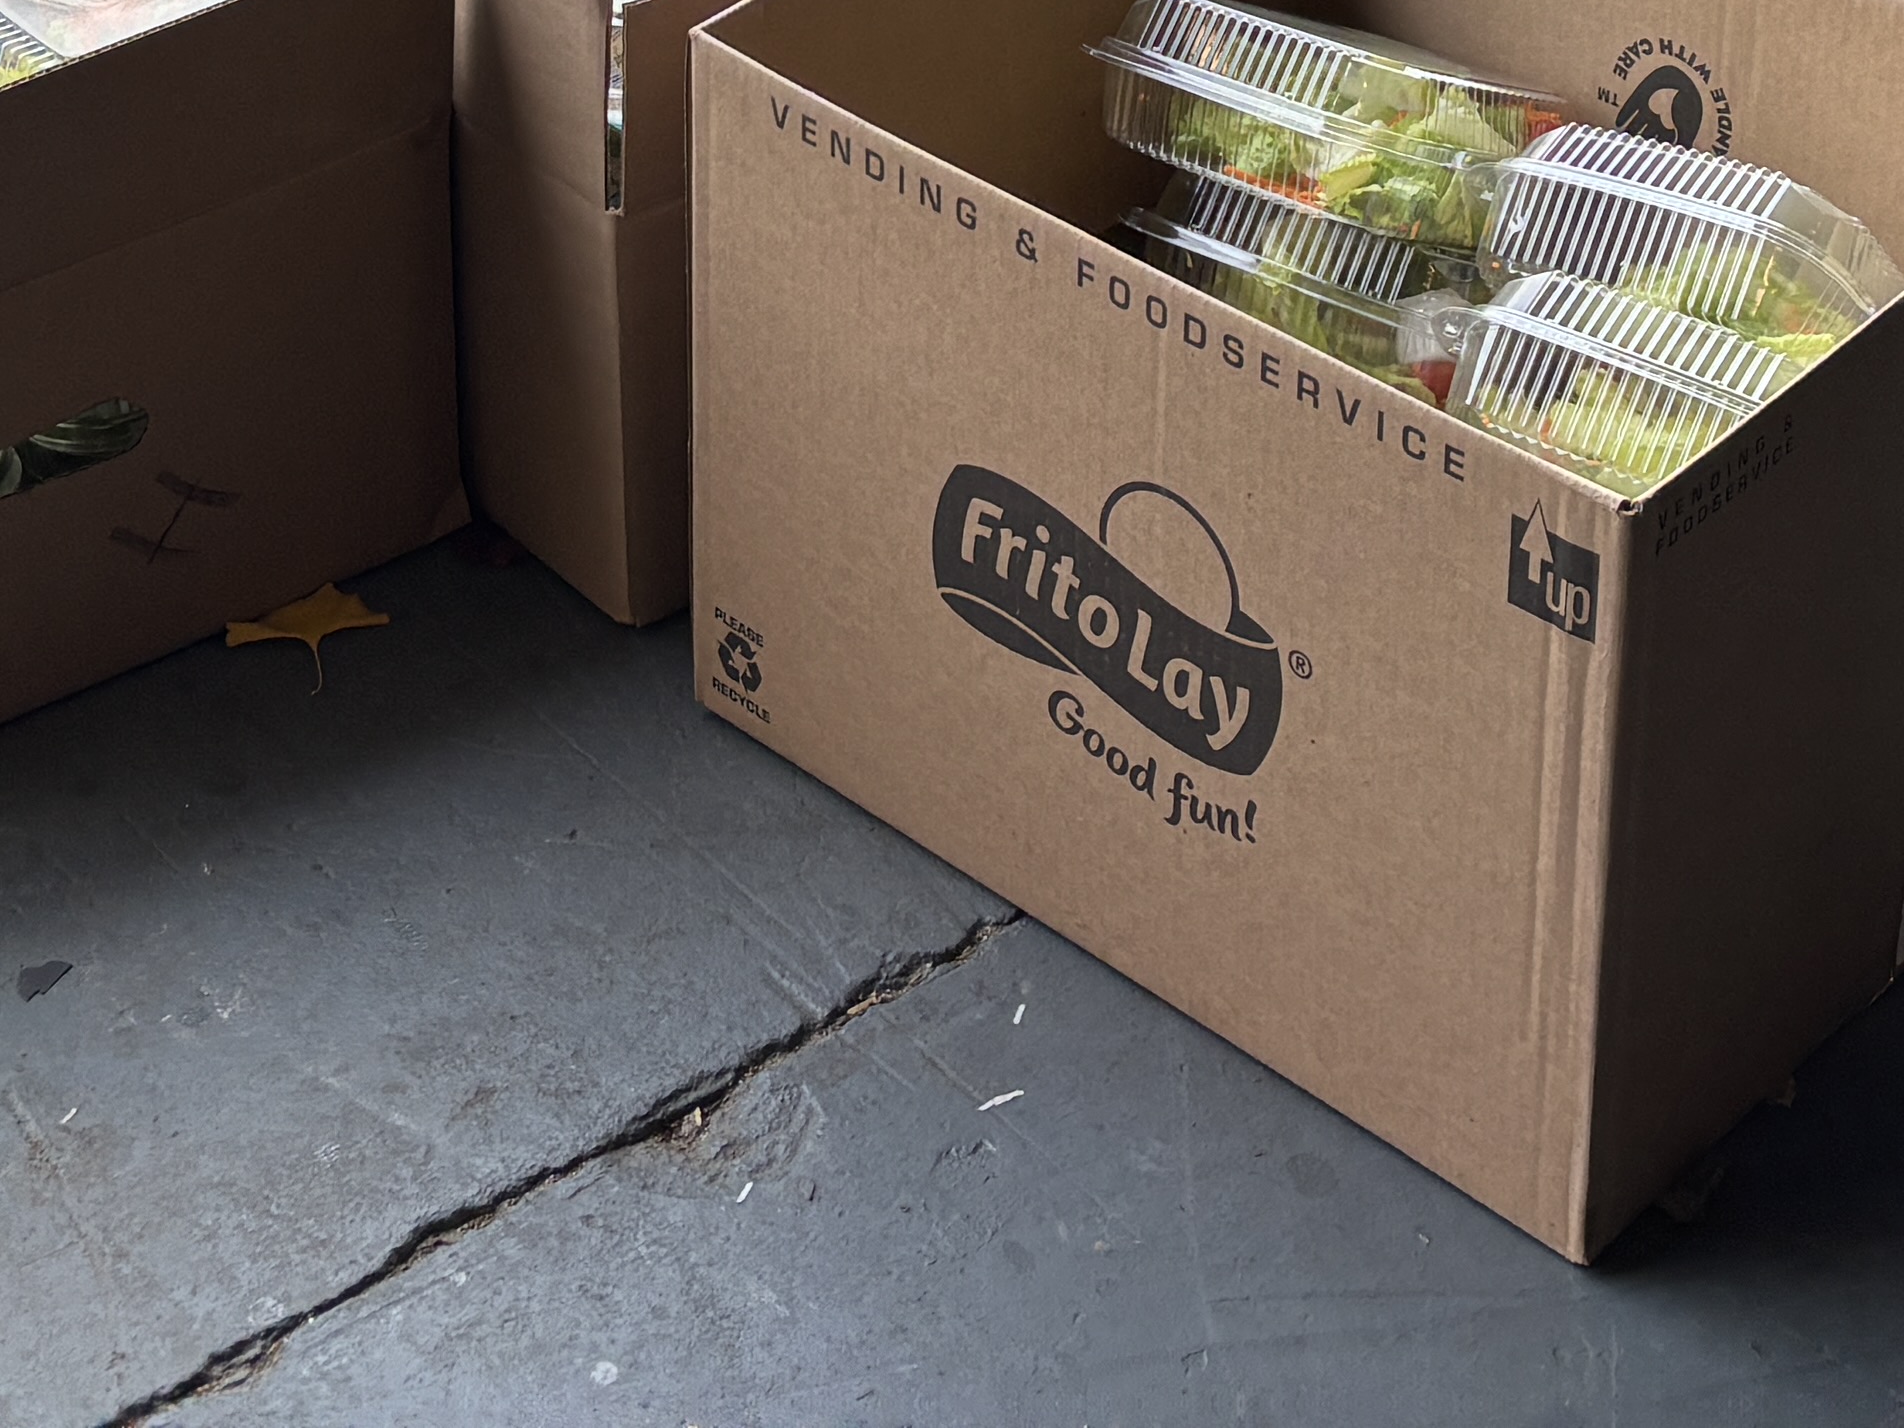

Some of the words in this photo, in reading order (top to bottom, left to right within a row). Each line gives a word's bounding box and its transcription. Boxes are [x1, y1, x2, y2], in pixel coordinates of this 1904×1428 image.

[1612, 37, 1654, 82] CARE
[1658, 37, 1712, 85] WITH
[1710, 87, 1733, 157] ANDLE
[770, 95, 978, 231] VENDING
[1014, 228, 1038, 264] &
[1076, 256, 1466, 483] FOODSERVICE
[1655, 435, 1795, 557] FOODSERVICE
[1657, 435, 1766, 531] VENDING
[714, 605, 764, 648] PLEASE
[1545, 570, 1592, 632] up
[711, 675, 771, 725] RECYCLE
[1047, 689, 1157, 802] Good
[1163, 772, 1257, 844] fun!
